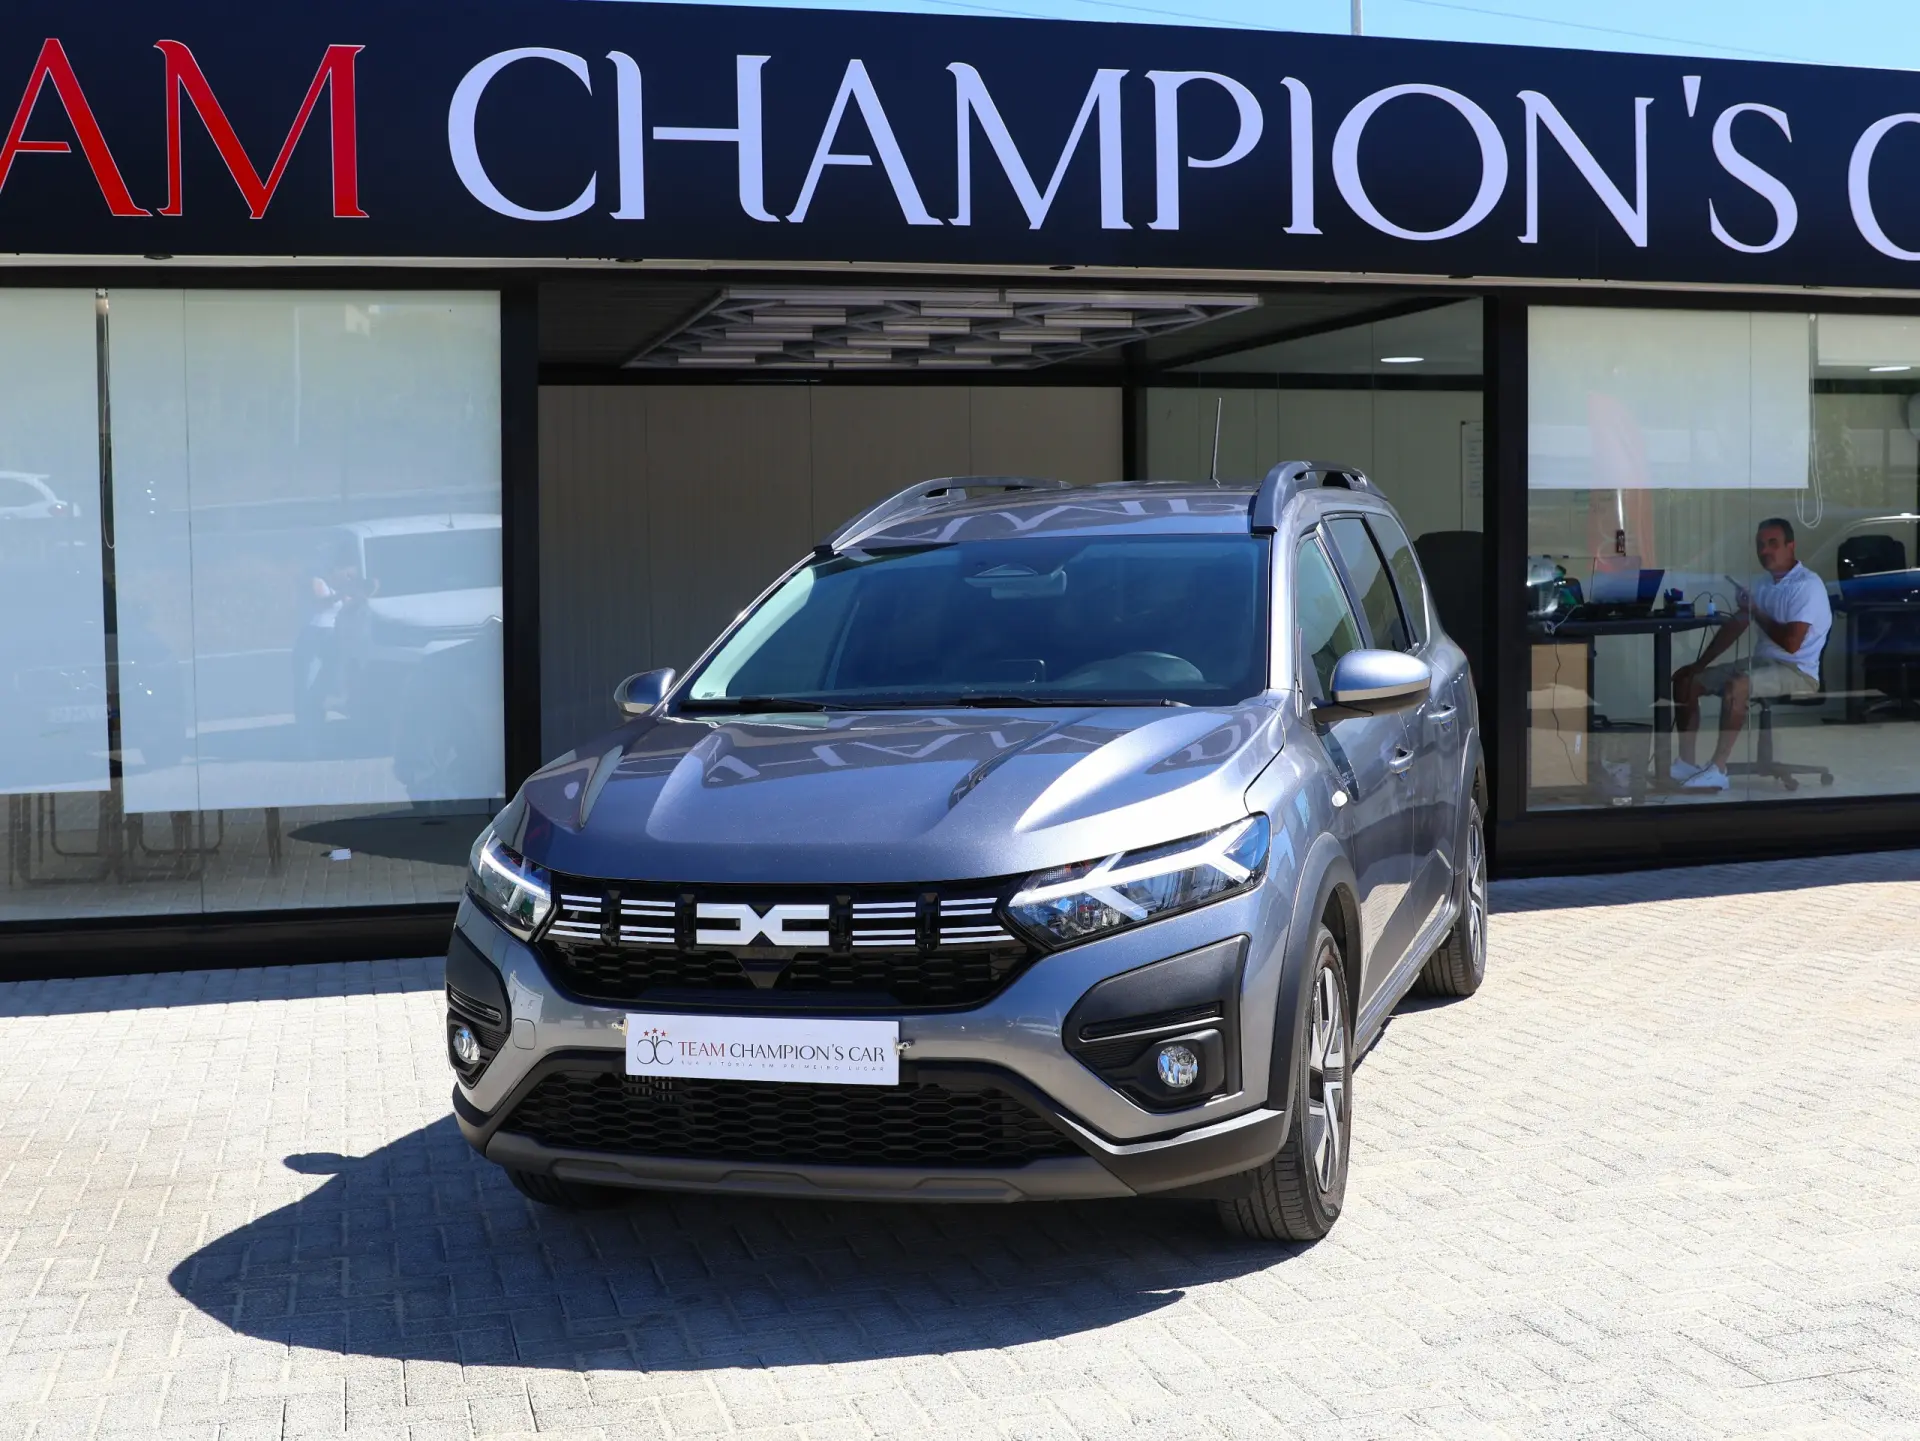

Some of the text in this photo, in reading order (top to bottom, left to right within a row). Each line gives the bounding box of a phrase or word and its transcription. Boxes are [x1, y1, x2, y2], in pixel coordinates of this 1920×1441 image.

[448, 47, 1798, 253] CHAMPION'S
[678, 1041, 885, 1062] TEAM CHAMPION'S CAR
